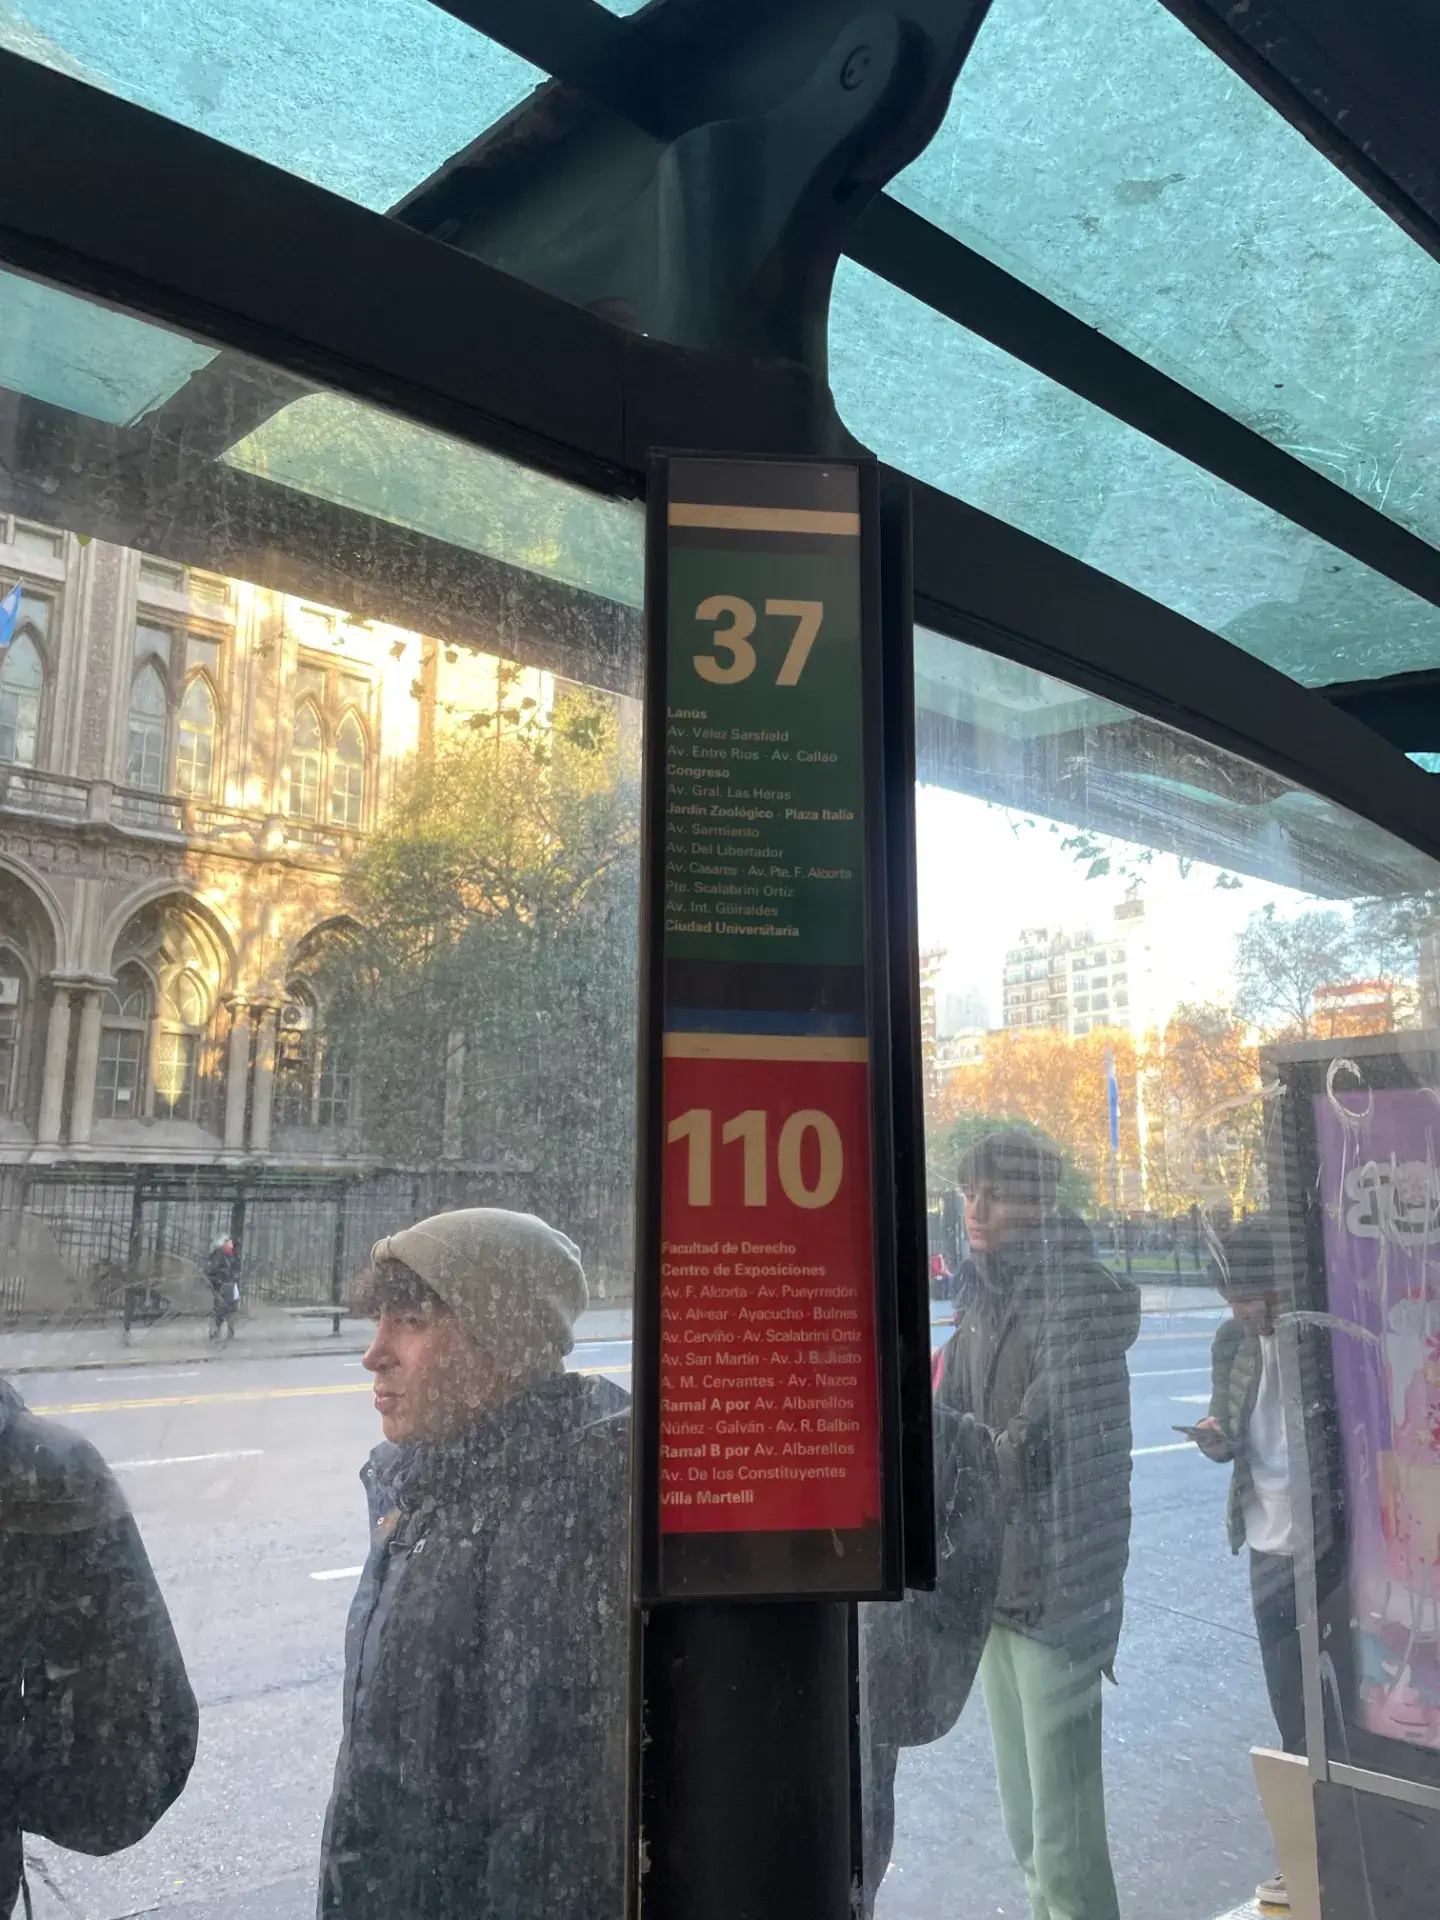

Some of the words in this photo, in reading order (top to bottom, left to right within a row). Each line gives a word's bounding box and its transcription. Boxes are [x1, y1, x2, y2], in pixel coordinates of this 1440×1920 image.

[693, 595, 824, 686] 37
[667, 706, 708, 719] Lanús
[668, 726, 688, 737] Av.
[731, 729, 789, 742] Sarsfield
[668, 746, 688, 757] Av.
[693, 747, 727, 758] Entre
[771, 750, 792, 761] Av.
[797, 750, 838, 763] Callao
[667, 764, 730, 779] Congreso
[668, 784, 687, 795] Av.
[692, 785, 723, 797] Gral.
[727, 786, 749, 799] Las
[754, 788, 792, 800] Heras
[710, 805, 774, 821] Zoológico
[785, 809, 818, 820] Plaza
[822, 809, 855, 821] Italia
[667, 823, 687, 834] Av.
[692, 823, 760, 838] Sarmiento
[666, 842, 687, 853] Av.
[692, 843, 712, 855] Del
[717, 843, 784, 858] Libertador
[666, 861, 686, 873] Av.
[689, 862, 738, 876] Casares
[748, 866, 767, 877] Av.
[770, 866, 791, 879] Pte.
[794, 867, 805, 879] F.
[807, 867, 852, 879] Alcorta
[665, 880, 690, 893] Pte.
[694, 882, 759, 896] Scalabrini
[763, 885, 795, 897] Ortiz
[666, 900, 686, 912] Av.
[690, 901, 712, 913] Int.
[665, 920, 712, 933] Ciudad
[715, 921, 799, 936] Universitaria
[667, 1109, 844, 1209] 110
[662, 1242, 718, 1254] Facultad
[722, 1242, 738, 1254] de
[741, 1242, 796, 1254] Derecho
[661, 1264, 710, 1277] Centro
[713, 1264, 731, 1276] de
[735, 1263, 826, 1279] Exposiciones
[661, 1287, 682, 1298] Av.
[686, 1286, 697, 1298] F.
[700, 1286, 748, 1298] Alcorta
[758, 1286, 779, 1298] Av.
[782, 1285, 858, 1300] Pueyrredón
[661, 1308, 682, 1320] Av.
[685, 1308, 729, 1320] Alvear
[738, 1308, 804, 1322] Ayacucho
[813, 1307, 858, 1320] Bulnes
[662, 1331, 681, 1344] Av.
[684, 1330, 735, 1343] Cerviño
[743, 1330, 764, 1342] Av.
[766, 1329, 829, 1342] Scalabrini
[832, 1329, 862, 1341] Ortiz
[661, 1353, 682, 1366] Av.
[685, 1352, 712, 1365] San
[771, 1352, 792, 1364] Av.
[795, 1351, 806, 1364] J.
[809, 1350, 822, 1364] B.
[825, 1350, 862, 1364] Justo
[661, 1376, 675, 1388] A.
[680, 1376, 698, 1388] M.
[703, 1375, 775, 1388] Cervantes
[788, 1375, 811, 1386] Av.
[816, 1374, 858, 1386] Nazca
[661, 1399, 706, 1412] Ramal
[710, 1399, 721, 1411] A
[726, 1400, 750, 1414] por
[754, 1397, 778, 1409] Av.
[783, 1396, 854, 1410] Albarellos
[661, 1422, 705, 1436] Núñez
[715, 1420, 765, 1434] Galván
[776, 1420, 797, 1433] Av.
[800, 1420, 814, 1432] R.
[660, 1444, 706, 1459] Ramal
[710, 1444, 721, 1457] B
[725, 1446, 750, 1459] por
[754, 1444, 778, 1456] Av.
[782, 1442, 855, 1456] Albarellos
[661, 1469, 684, 1481] Av.
[688, 1467, 708, 1480] De
[712, 1467, 734, 1480] los
[738, 1466, 847, 1482] Constituyentes
[660, 1491, 692, 1505] Villa
[696, 1490, 754, 1504] Martelli
